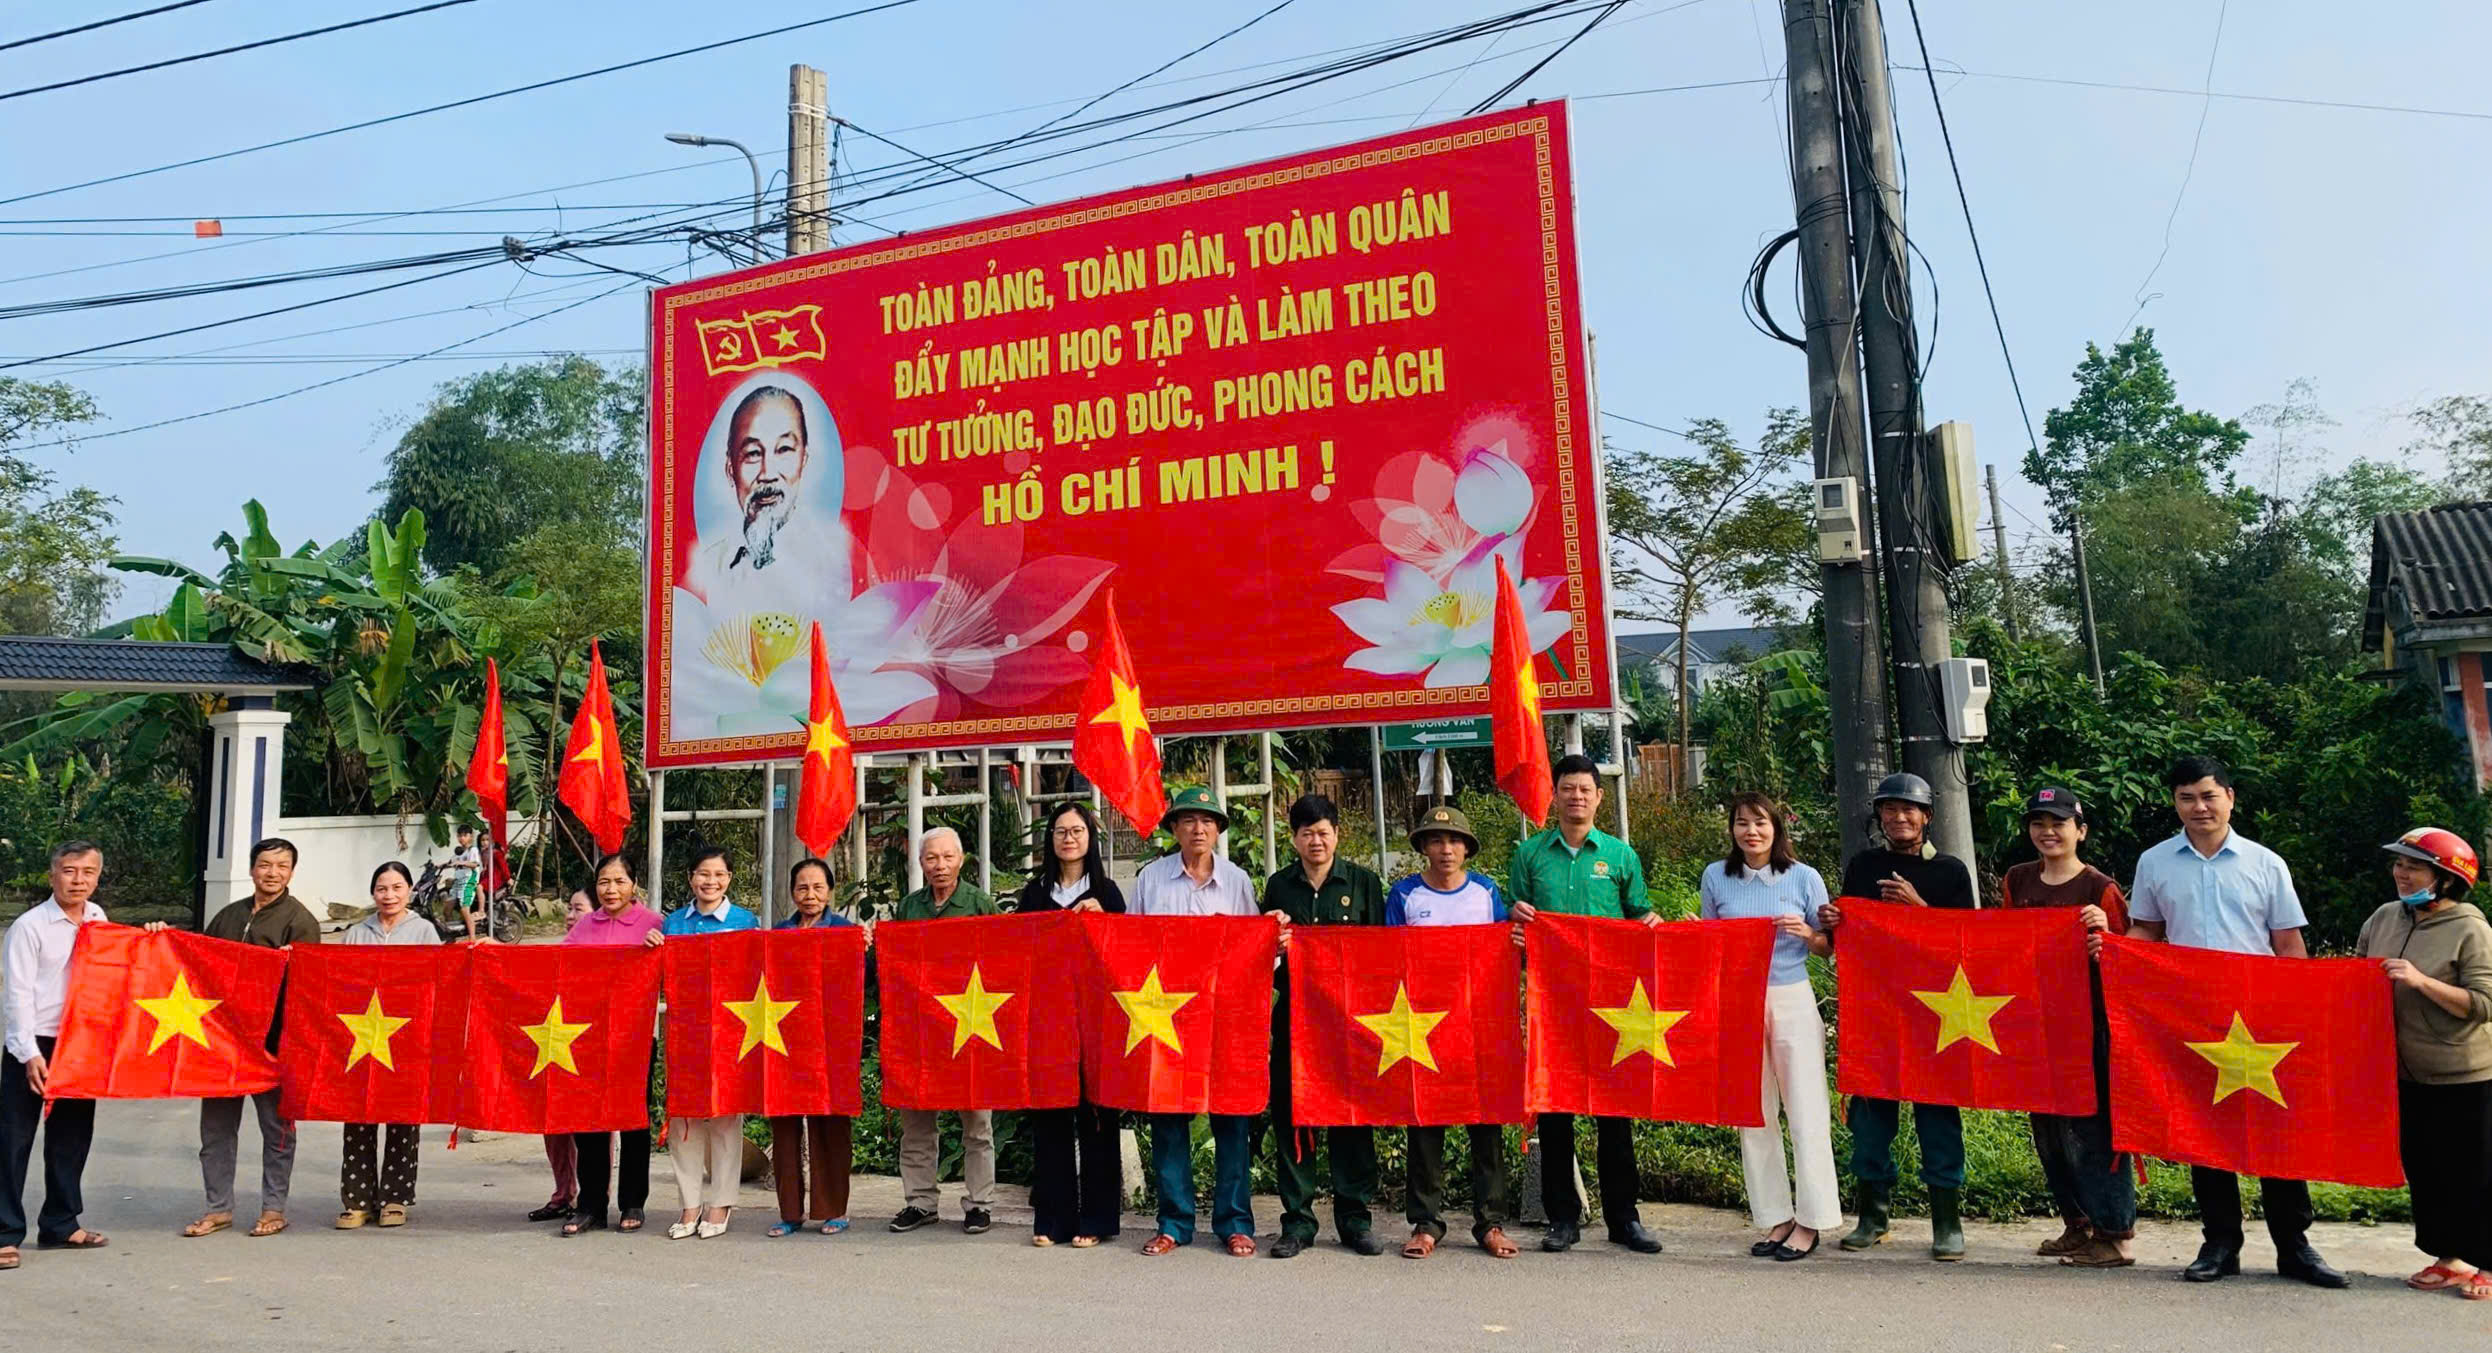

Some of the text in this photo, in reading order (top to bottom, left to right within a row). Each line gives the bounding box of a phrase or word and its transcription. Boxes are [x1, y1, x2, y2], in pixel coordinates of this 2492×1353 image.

[879, 187, 1451, 334] TOÀN ĐẢNG, TOÀN DÂN, TOÀN QUÂN
[895, 271, 1436, 400] ĐẨY MẠNH HỌC TẬP VÀ LÀM THEO
[892, 345, 1445, 467] TƯ TƯỞNG, ĐẠO ĐỨC, PHONG CÁCH
[983, 440, 1336, 526] HỒ CHÍ MINH !
